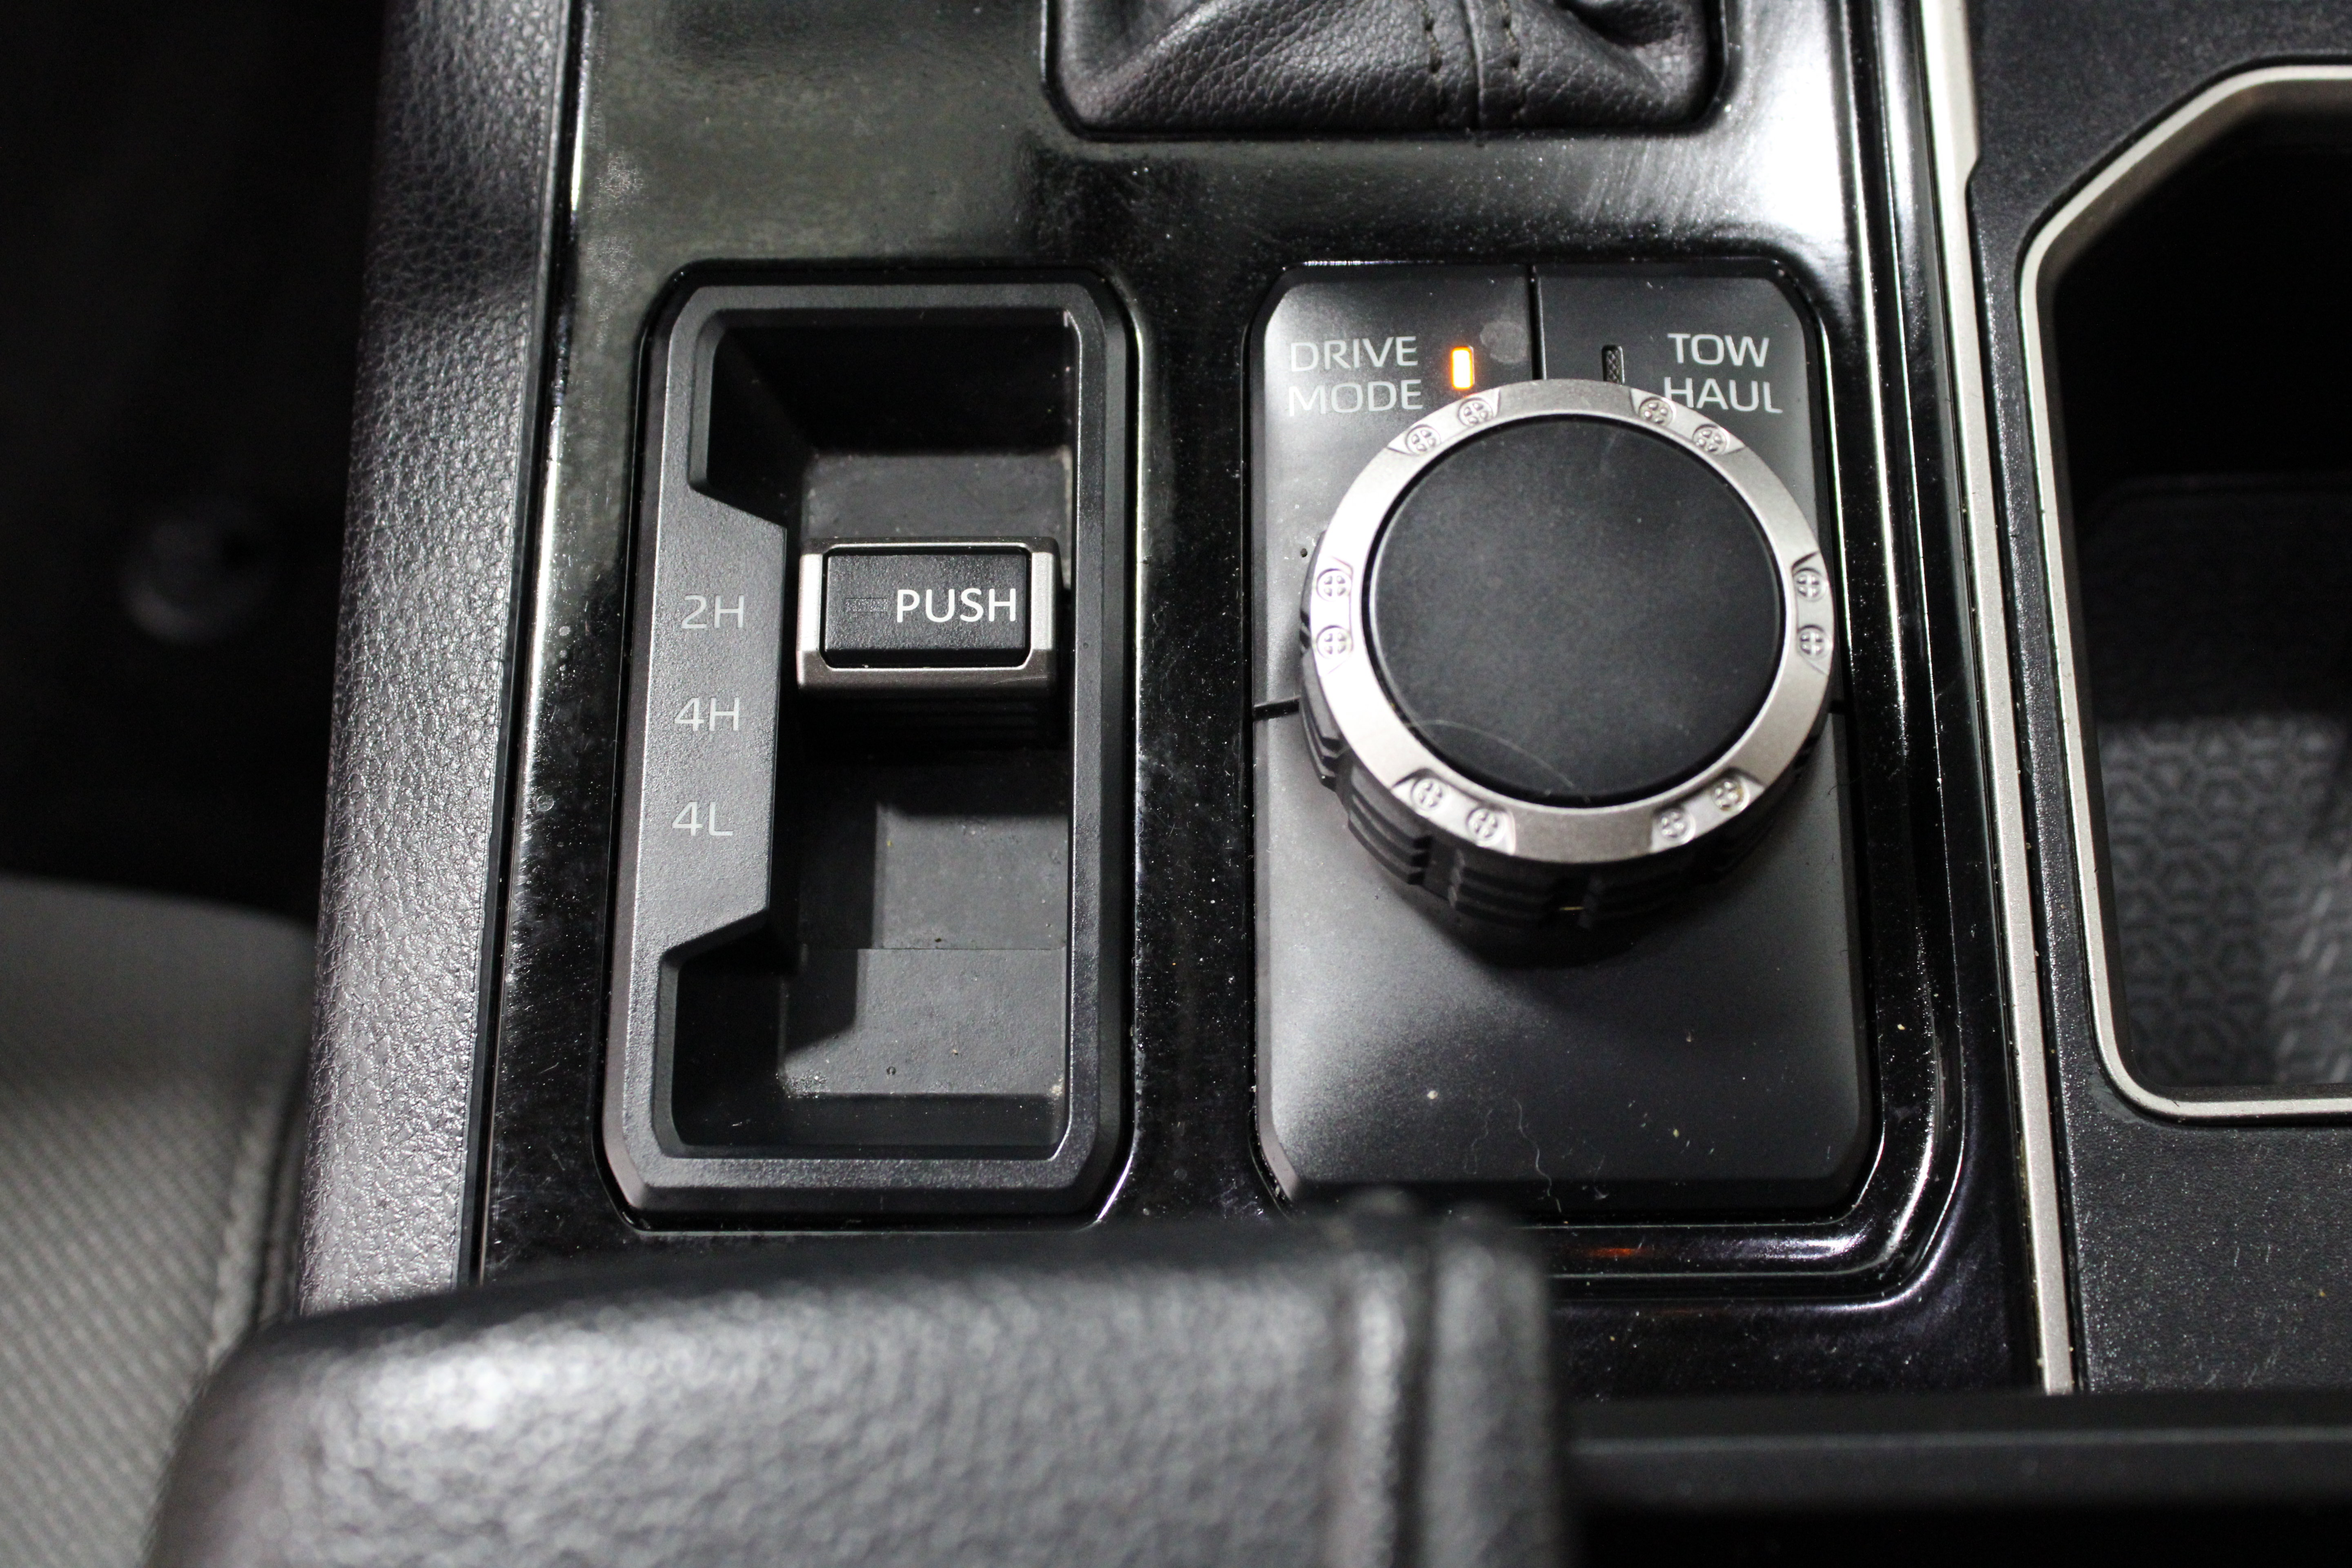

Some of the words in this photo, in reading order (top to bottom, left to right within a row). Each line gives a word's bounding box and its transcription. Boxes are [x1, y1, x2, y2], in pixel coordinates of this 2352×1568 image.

[1290, 336, 1419, 372] DRIVE
[1667, 333, 1769, 367] TOW
[1288, 380, 1423, 416] MODE
[1664, 376, 1783, 414] HAUL
[680, 594, 746, 629] 2H
[896, 587, 1016, 623] PUSH
[674, 697, 740, 732] 4H
[671, 801, 734, 837] 4L
